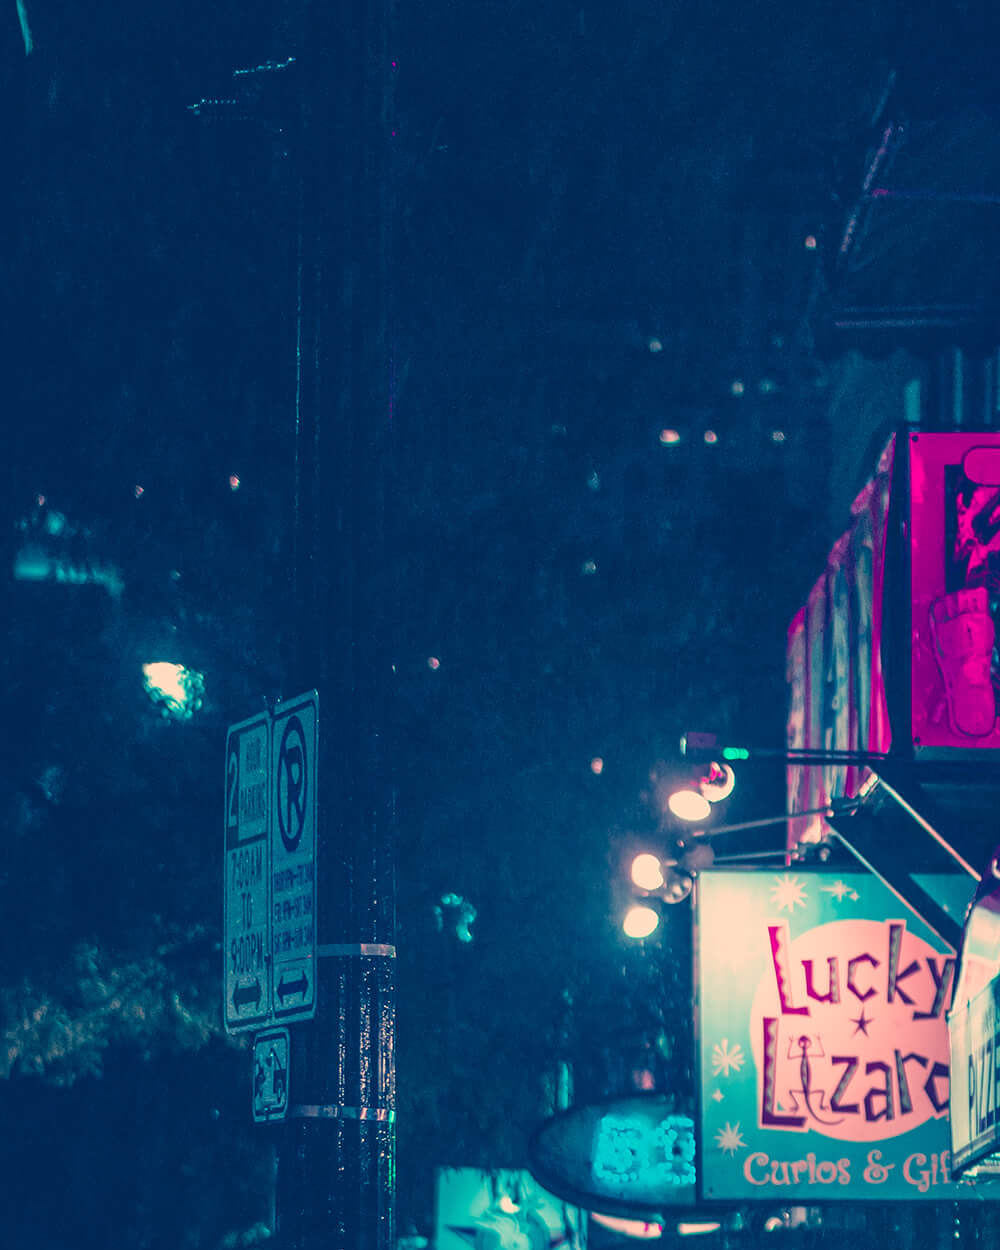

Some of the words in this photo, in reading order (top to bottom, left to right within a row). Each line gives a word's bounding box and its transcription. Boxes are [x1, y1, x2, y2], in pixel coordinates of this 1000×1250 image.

[228, 751, 238, 827] 2
[768, 923, 956, 1021] Lucky
[743, 1152, 851, 1187] Curios
[863, 1149, 895, 1185] &
[903, 1151, 952, 1193] Gif
